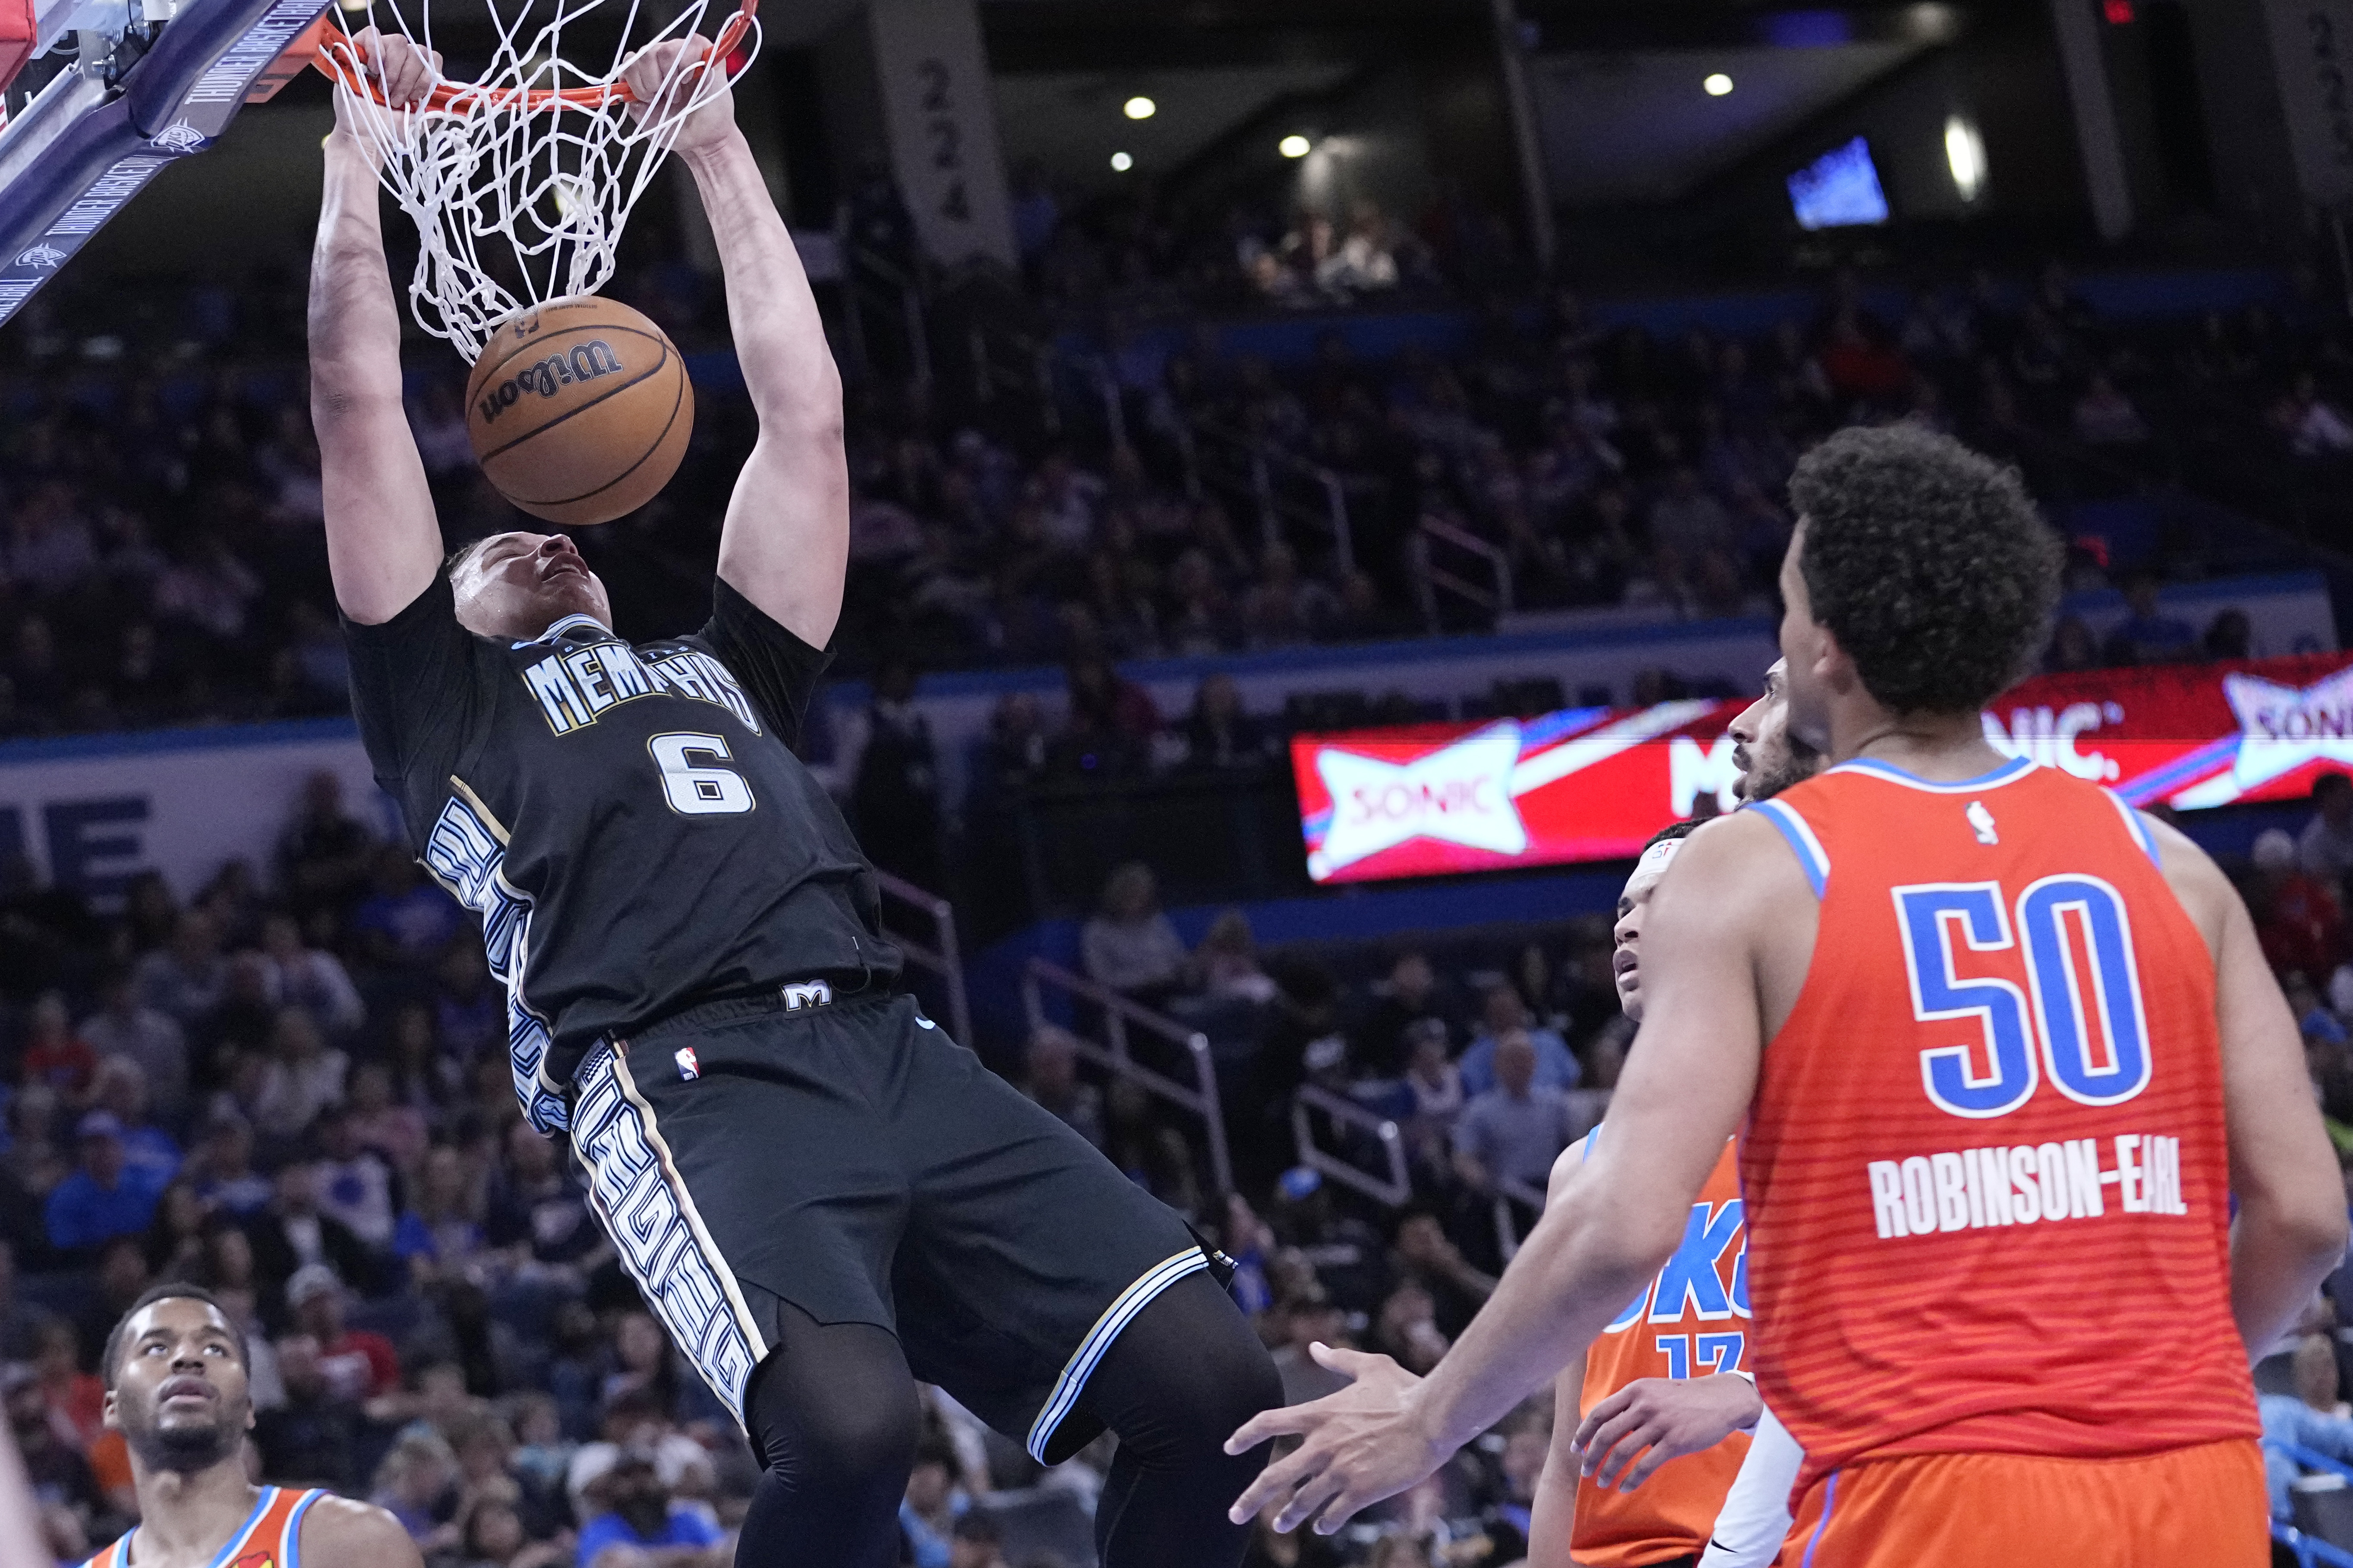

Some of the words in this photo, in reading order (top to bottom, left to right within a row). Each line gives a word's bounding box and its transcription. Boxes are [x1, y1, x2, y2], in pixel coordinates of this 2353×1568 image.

[184, 56, 269, 105] THUNDER
[44, 199, 123, 236] THUNDER
[479, 339, 624, 425] Wilson
[647, 731, 756, 818] 6
[1349, 775, 1492, 823] SONIC
[1891, 872, 2153, 1119] 50
[1868, 1134, 2187, 1239] ROBINSON-EARL
